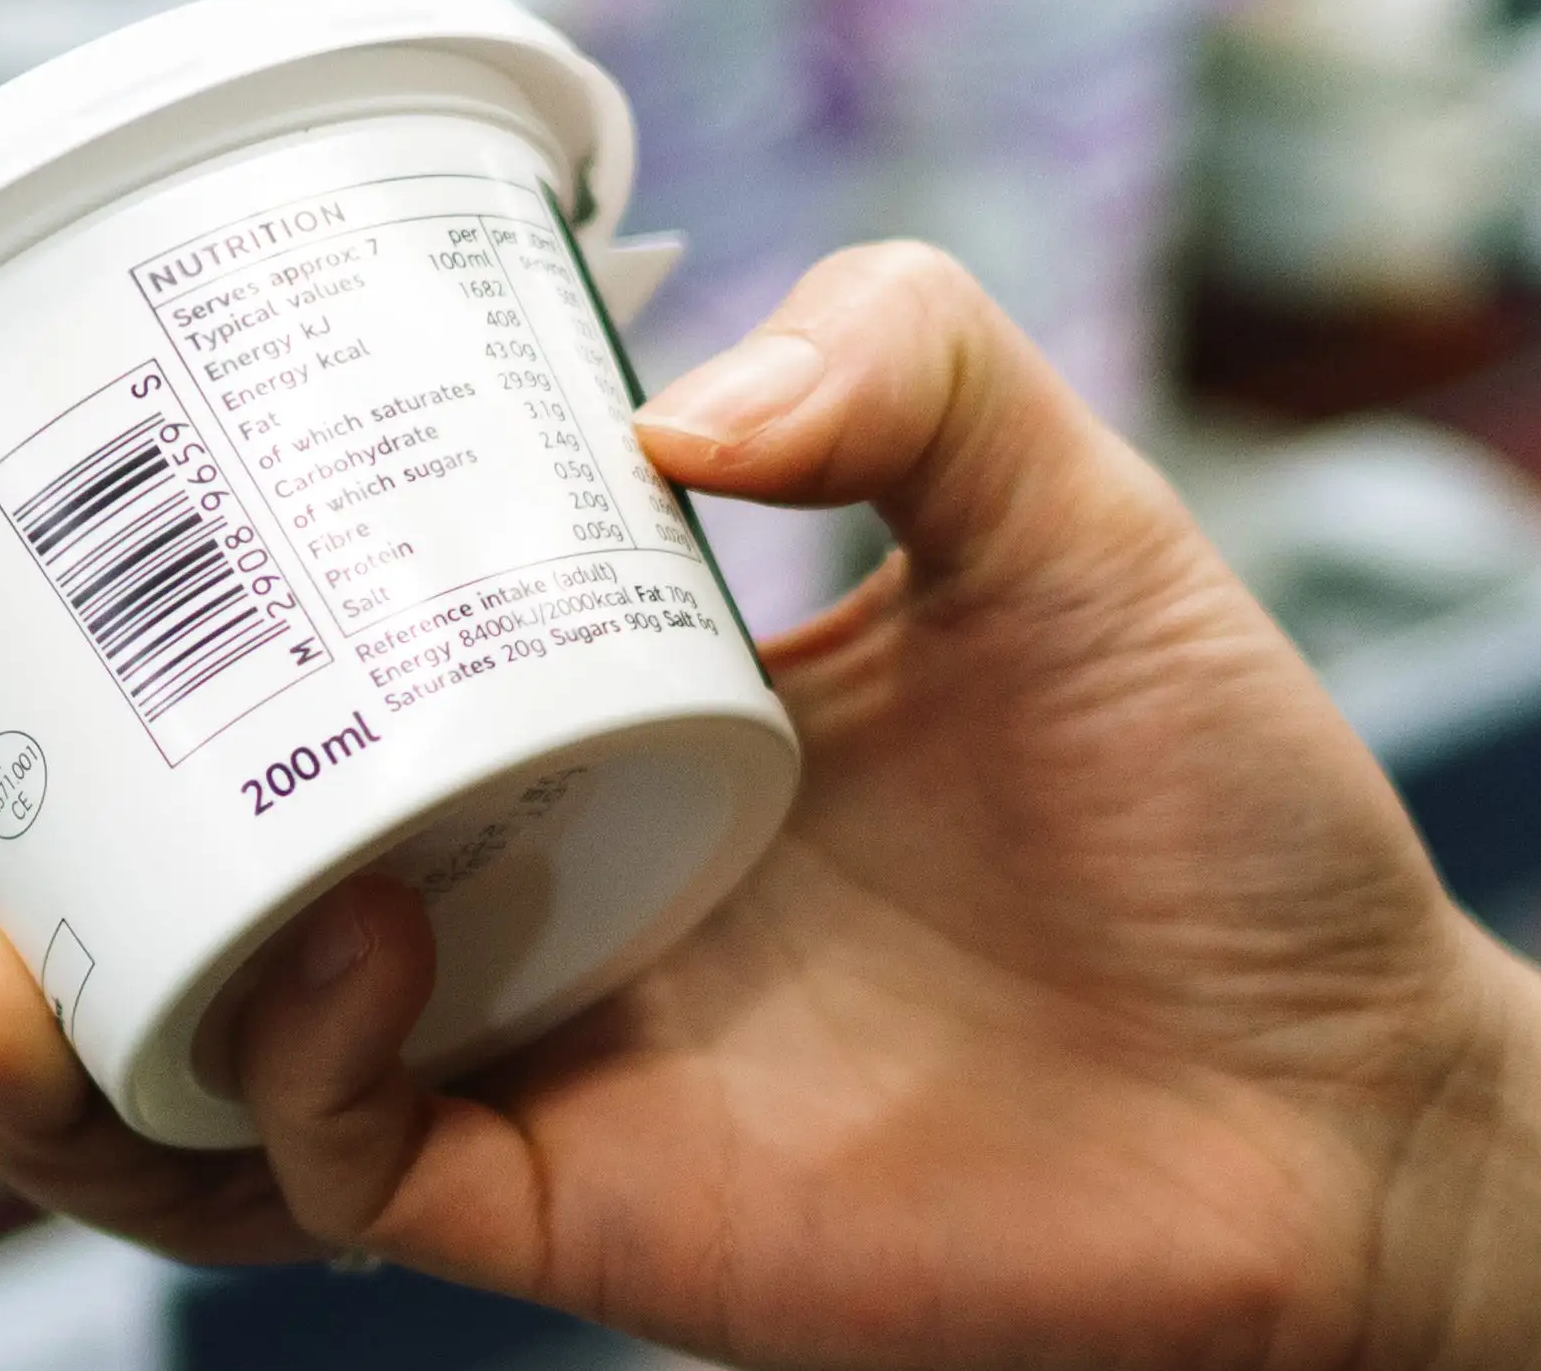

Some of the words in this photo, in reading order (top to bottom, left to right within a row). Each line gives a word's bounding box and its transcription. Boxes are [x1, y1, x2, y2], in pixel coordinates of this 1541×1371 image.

[148, 201, 346, 293] NUTRITION
[173, 280, 260, 329] Serves
[365, 237, 379, 256] 7
[447, 227, 480, 249] per
[491, 227, 520, 248] per
[184, 300, 281, 352] Typical
[286, 272, 367, 310] values
[428, 249, 495, 273] 100ml
[203, 333, 292, 382] Energy
[299, 314, 332, 340] kJ
[457, 279, 507, 301] 1682
[130, 374, 163, 400] S
[220, 363, 309, 412] Energy
[315, 339, 372, 371] kcal
[486, 308, 522, 329] 408
[159, 422, 231, 512] 9659
[238, 411, 282, 442] Fat
[258, 444, 284, 470] of
[291, 413, 365, 453] which
[370, 380, 477, 423] saturates
[274, 423, 440, 499] Carbohydrate
[293, 503, 318, 530] of
[325, 473, 397, 514] which
[402, 447, 479, 484] sugars
[307, 521, 372, 560] Fibre
[553, 460, 596, 483] 0.5g
[224, 525, 298, 620] 2908
[324, 540, 416, 590] Protein
[342, 584, 392, 620] Salt
[572, 521, 626, 543] 0.05g
[288, 636, 324, 667] M
[354, 598, 474, 665] Reference
[478, 578, 548, 611] intake
[553, 560, 618, 591] (adult)
[369, 639, 453, 689] Energy
[458, 587, 632, 650] 8400kJ/2000kcal
[634, 583, 665, 604] Fat
[669, 585, 698, 610] 70g
[383, 654, 497, 714] Saturates
[501, 635, 548, 664] 20g
[552, 612, 622, 648] Sugars
[624, 612, 663, 634] 90g
[663, 607, 696, 629] Salt
[698, 613, 720, 636] 6g
[10, 790, 34, 821] CE
